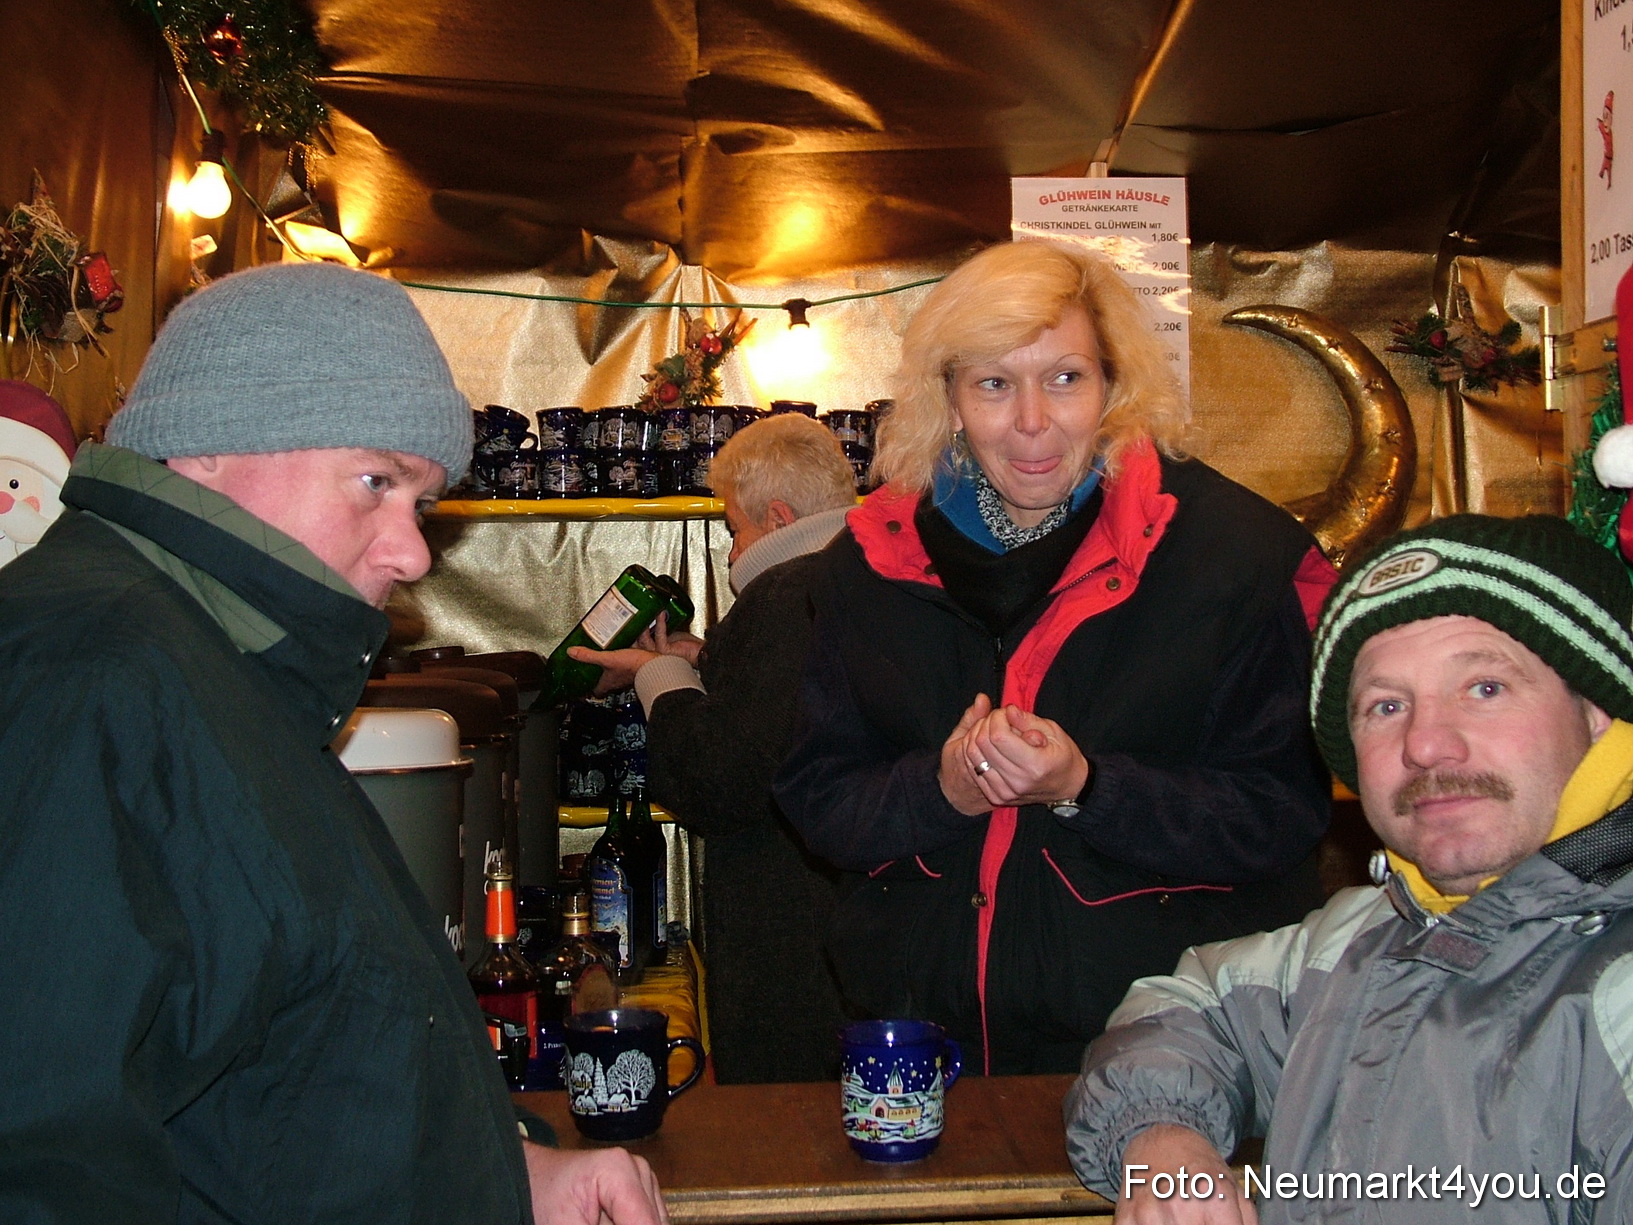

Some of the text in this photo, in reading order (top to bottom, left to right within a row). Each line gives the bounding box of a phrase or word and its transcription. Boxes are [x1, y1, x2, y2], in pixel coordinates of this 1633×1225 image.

[1620, 24, 1633, 53] 1,
[1039, 189, 1170, 206] GLÜHWEIN HÄUSLE
[1062, 204, 1139, 213] GETRÄNKEKARTE
[1020, 221, 1092, 231] CHRISTKINDEL
[1094, 219, 1147, 230] GLÜHWEIN
[1151, 232, 1179, 243] 1,80€
[1590, 232, 1633, 265] 2,00 Tas
[1152, 261, 1180, 271] 2,00€
[1154, 322, 1182, 332] 2,20€
